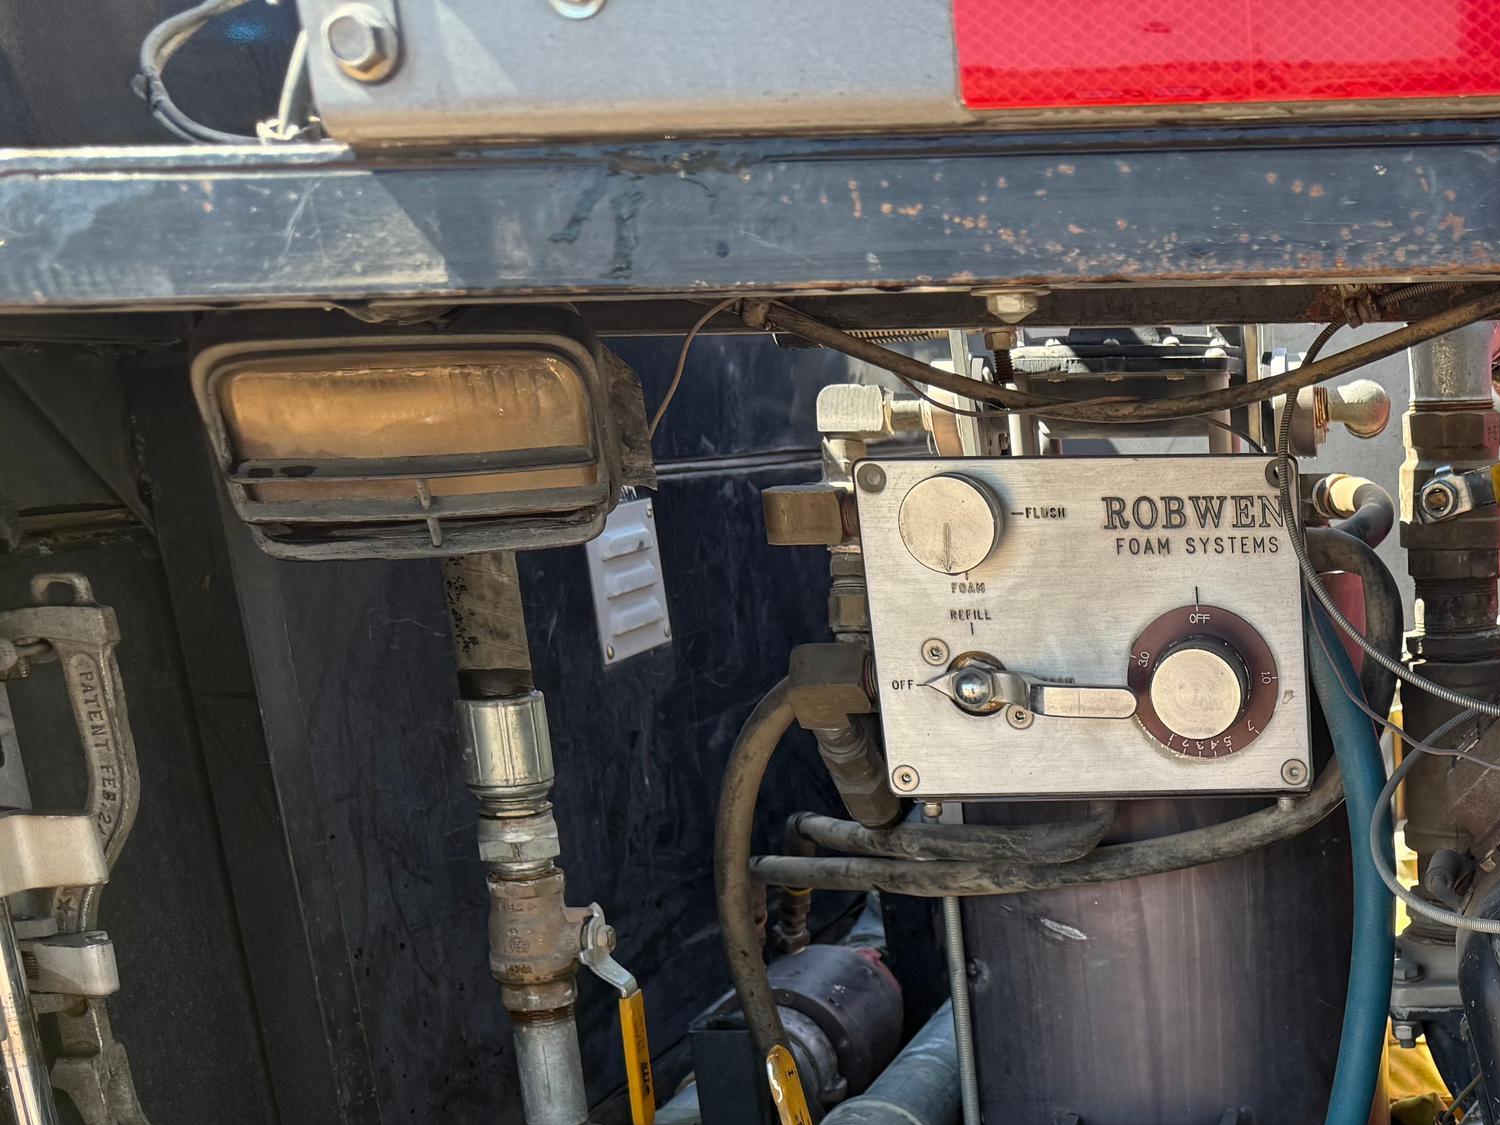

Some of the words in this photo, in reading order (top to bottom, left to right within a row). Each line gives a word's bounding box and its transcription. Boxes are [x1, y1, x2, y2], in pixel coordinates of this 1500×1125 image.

[1025, 507, 1066, 519] FLUSH
[1101, 495, 1284, 529] ROBWEN
[1115, 537, 1171, 555] FOAM
[1185, 536, 1279, 554] SYSTEMS
[951, 582, 986, 594] FOAM
[950, 609, 992, 621] REFILL
[1189, 614, 1210, 624] OFF
[891, 679, 914, 690] OFF
[80, 670, 110, 750] PATENT
